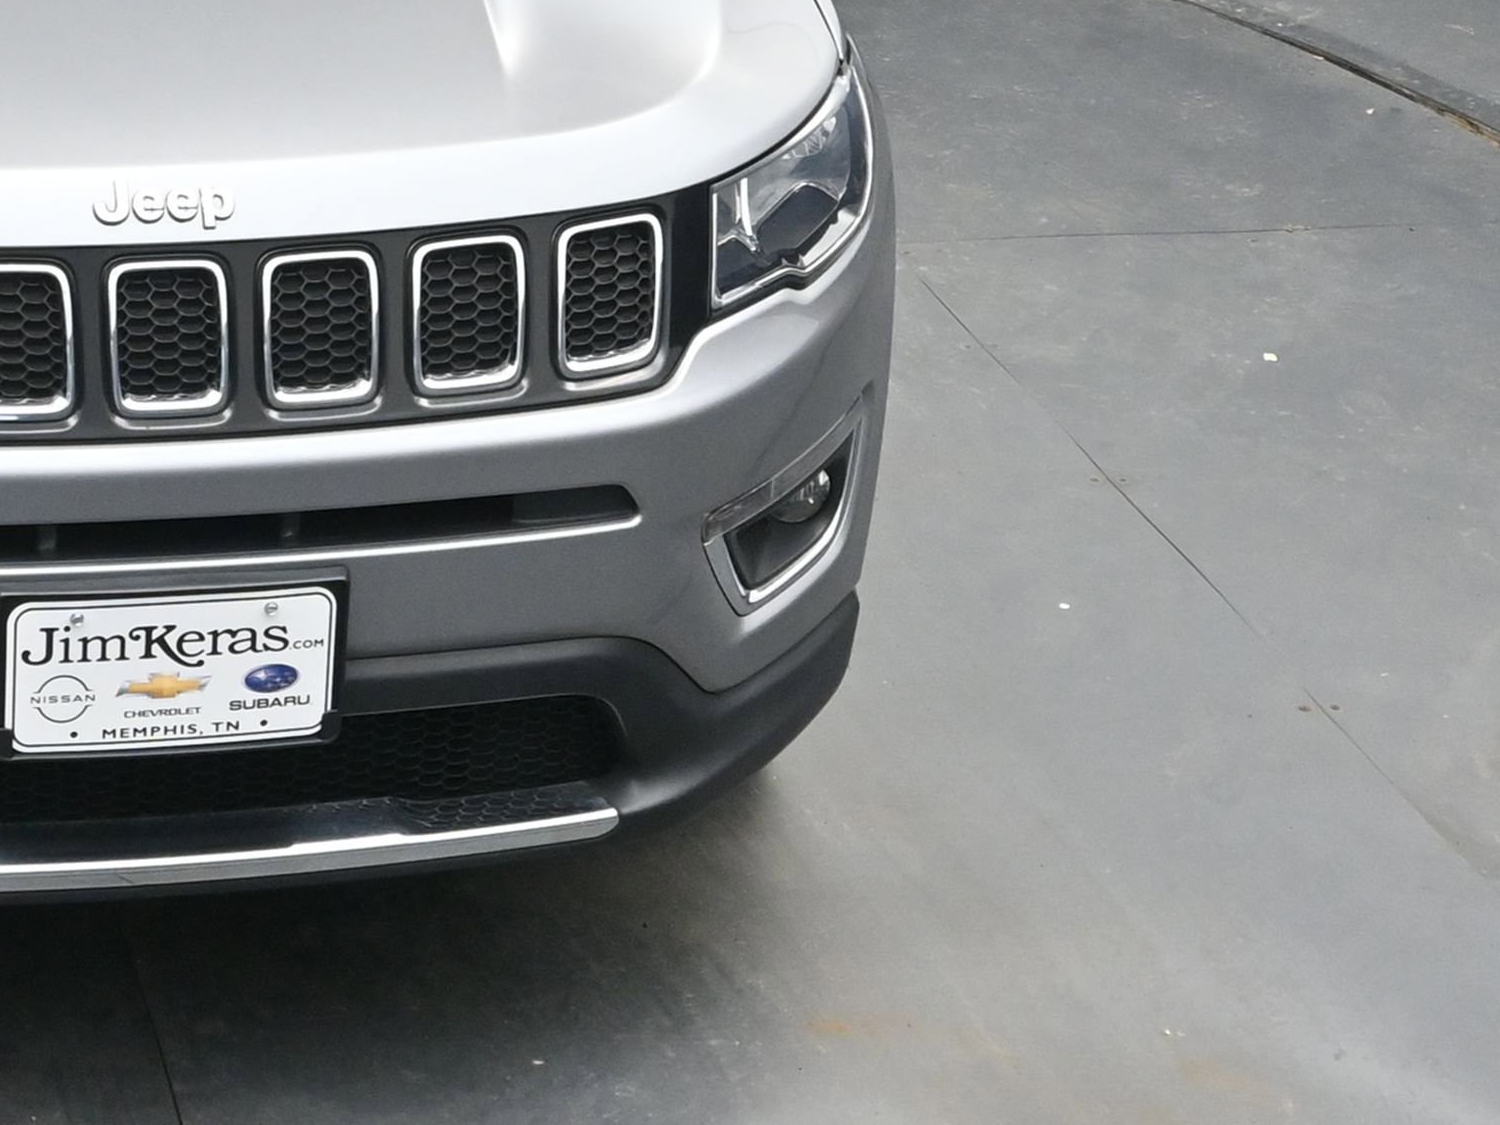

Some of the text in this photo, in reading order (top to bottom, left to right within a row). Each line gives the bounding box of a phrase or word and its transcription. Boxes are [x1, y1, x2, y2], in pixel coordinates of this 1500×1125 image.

[92, 179, 236, 230] Jeep
[30, 692, 96, 705] NISSAN
[229, 695, 311, 712] SUBARU
[123, 706, 202, 719] CHEVROLET
[102, 720, 240, 740] MEMPHIS, TN
